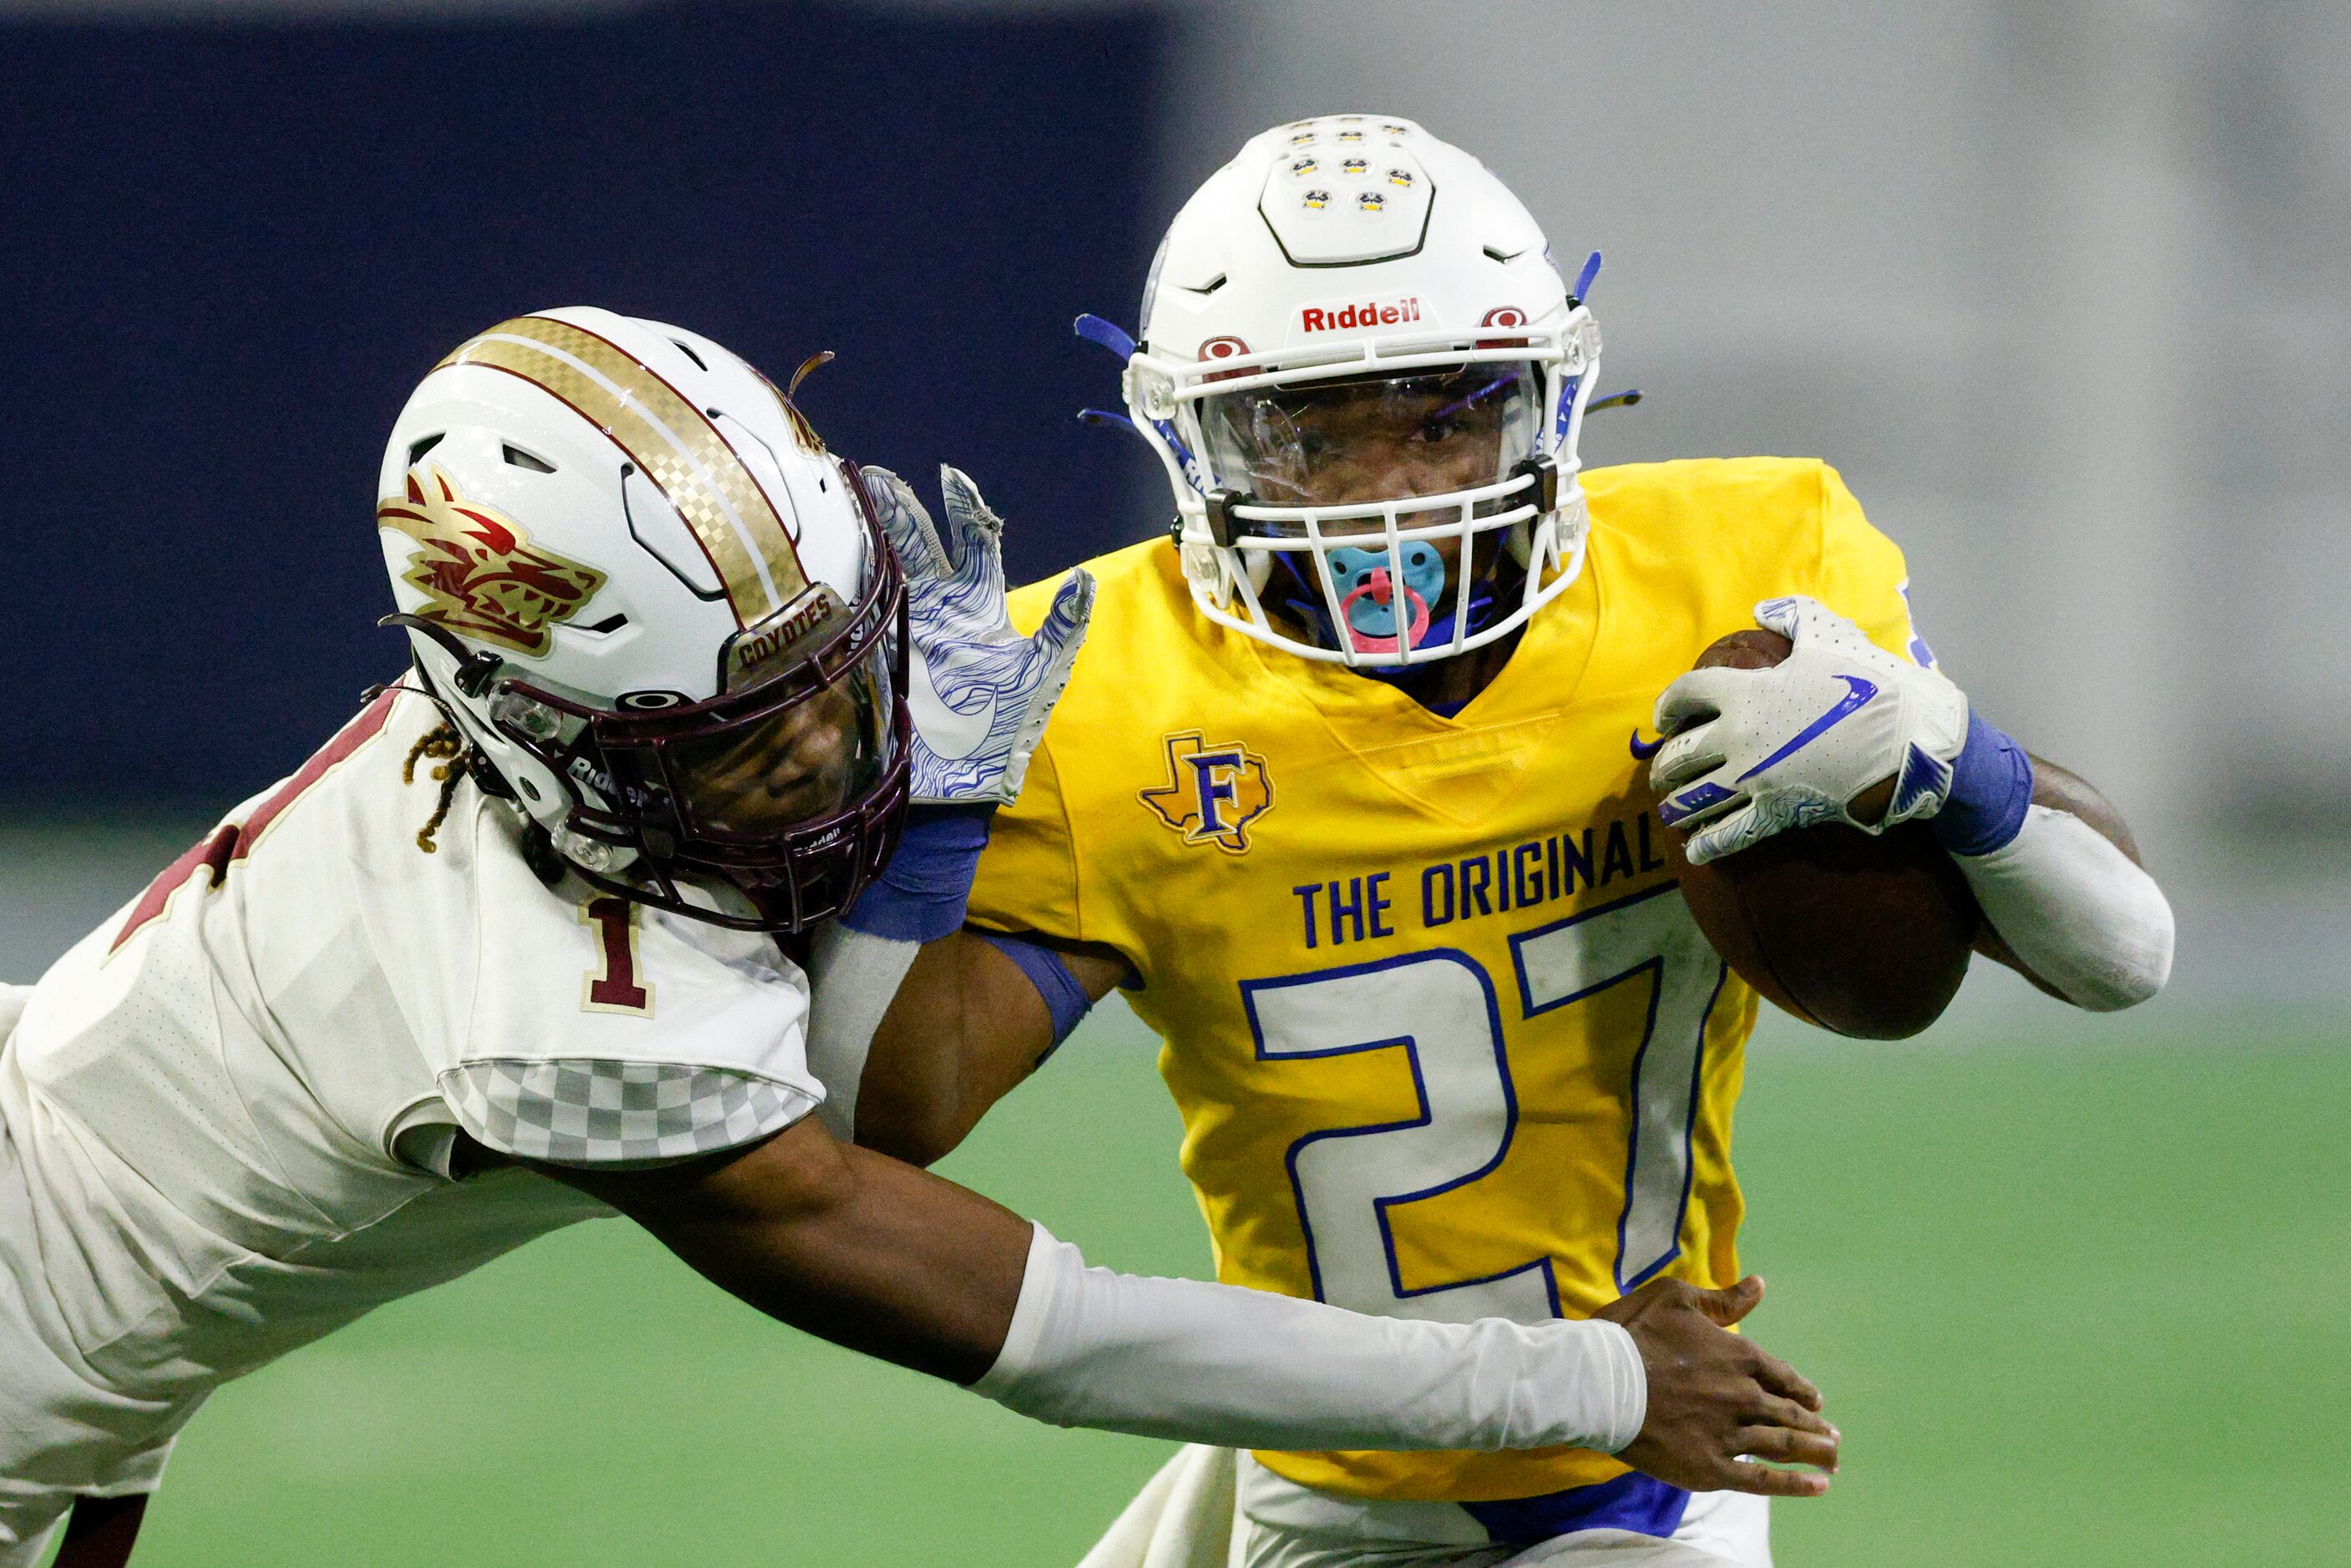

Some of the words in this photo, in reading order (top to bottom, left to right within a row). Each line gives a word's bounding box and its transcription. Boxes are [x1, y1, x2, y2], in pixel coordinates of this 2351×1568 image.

[1302, 297, 1420, 332] Riddell
[738, 594, 832, 668] COYOTES
[1181, 748, 1246, 840] F
[1293, 872, 1393, 948] THE
[1422, 811, 1665, 928] ORIGINAL
[583, 893, 652, 1015] 1
[1238, 879, 1728, 1319] 27
